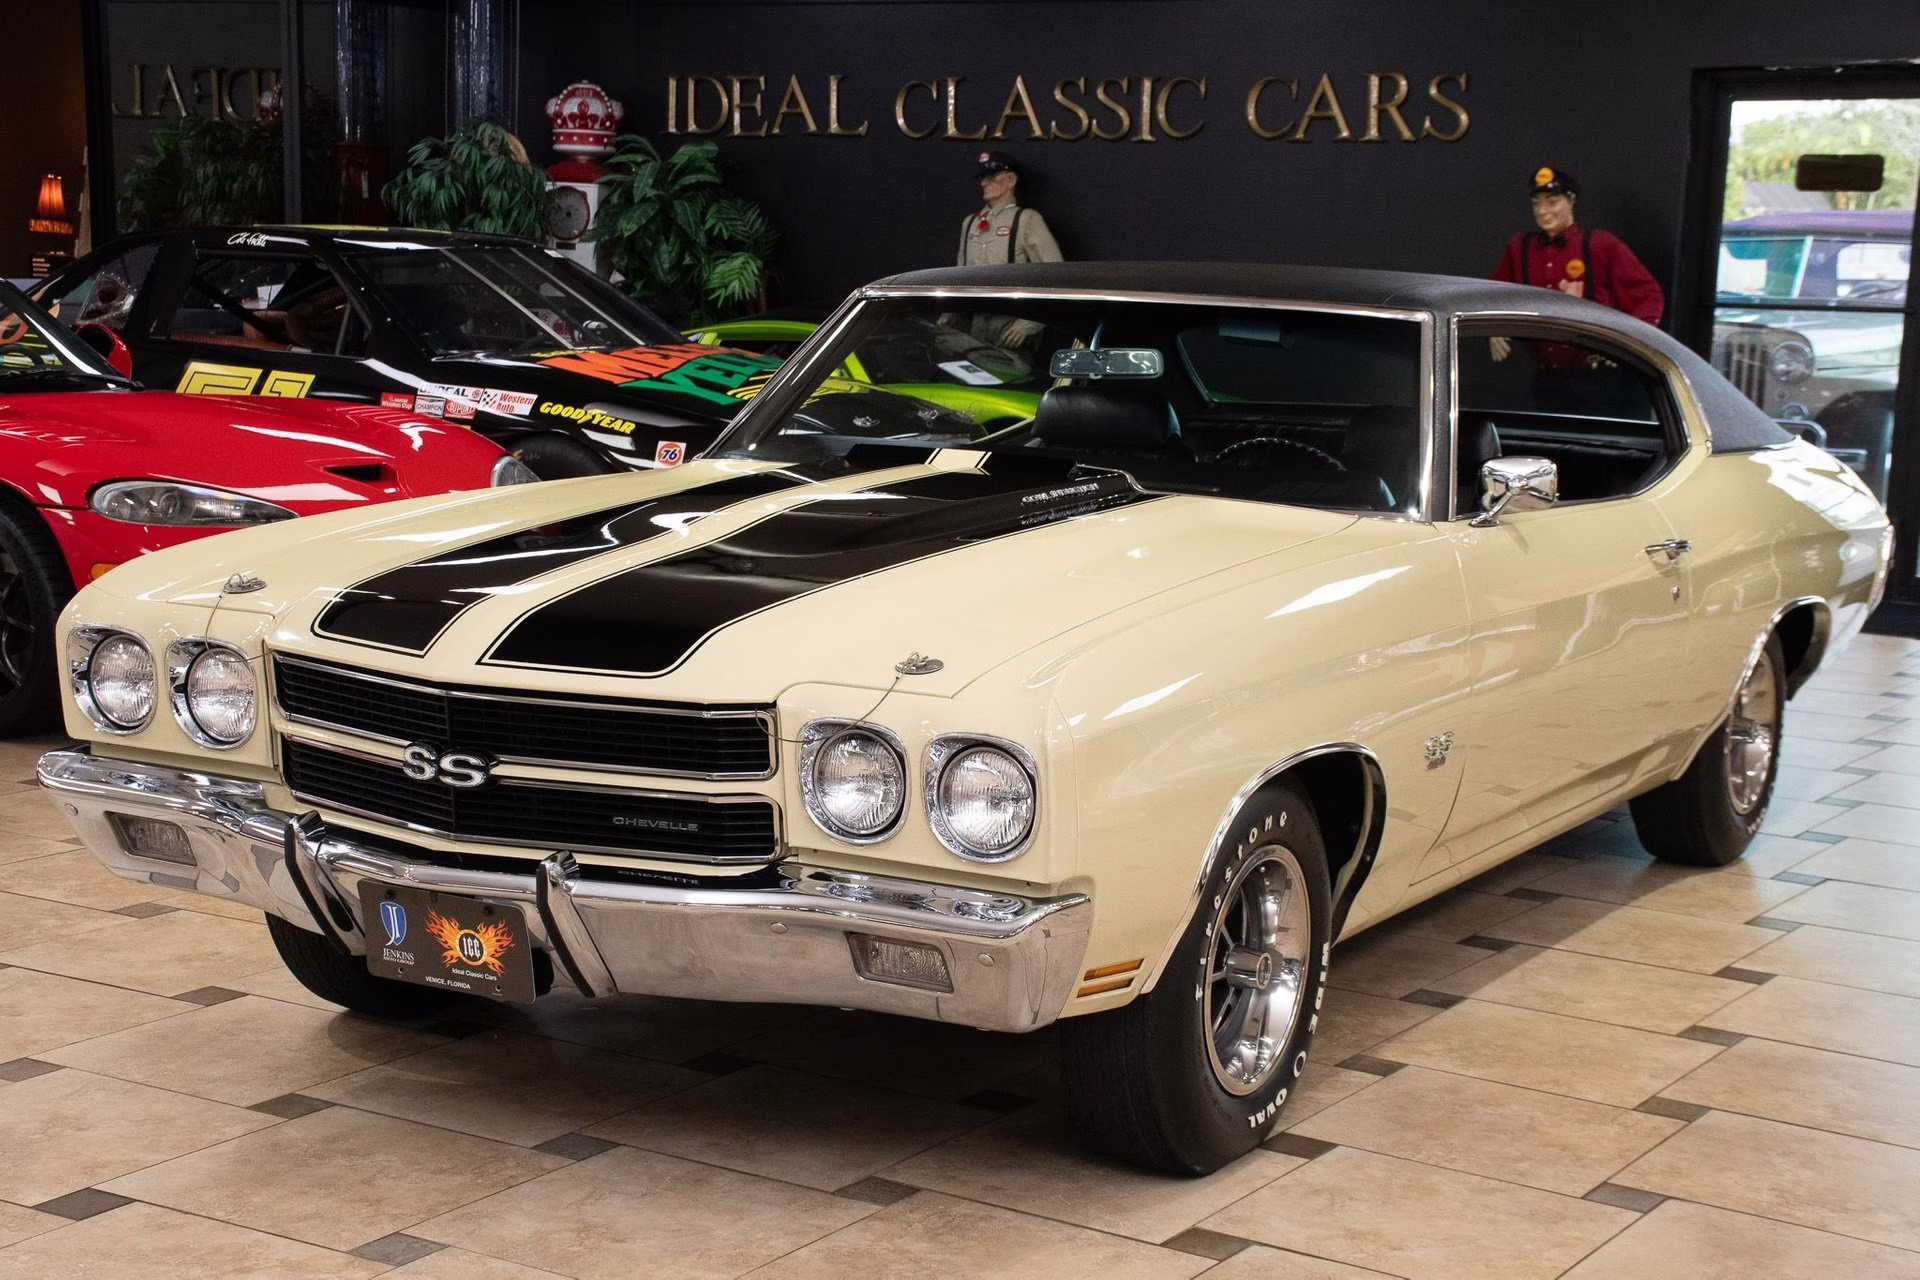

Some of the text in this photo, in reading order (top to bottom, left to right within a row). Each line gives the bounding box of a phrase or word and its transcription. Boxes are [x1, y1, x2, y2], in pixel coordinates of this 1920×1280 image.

[664, 72, 1470, 142] IDEAL CLASSIC CARS
[419, 385, 469, 397] UOCAL
[500, 393, 534, 405] Western
[540, 402, 635, 434] GOODYEAR
[662, 449, 678, 460] 76
[403, 745, 486, 788] SS
[613, 816, 699, 832] CHEVELLE
[383, 948, 415, 961] JENKINS
[451, 967, 498, 981] Ideal Classic Cars
[425, 976, 471, 990] VENICE, FLORIDA
[1308, 941, 1330, 1035] WIDE
[1247, 1087, 1288, 1128] OVAL
